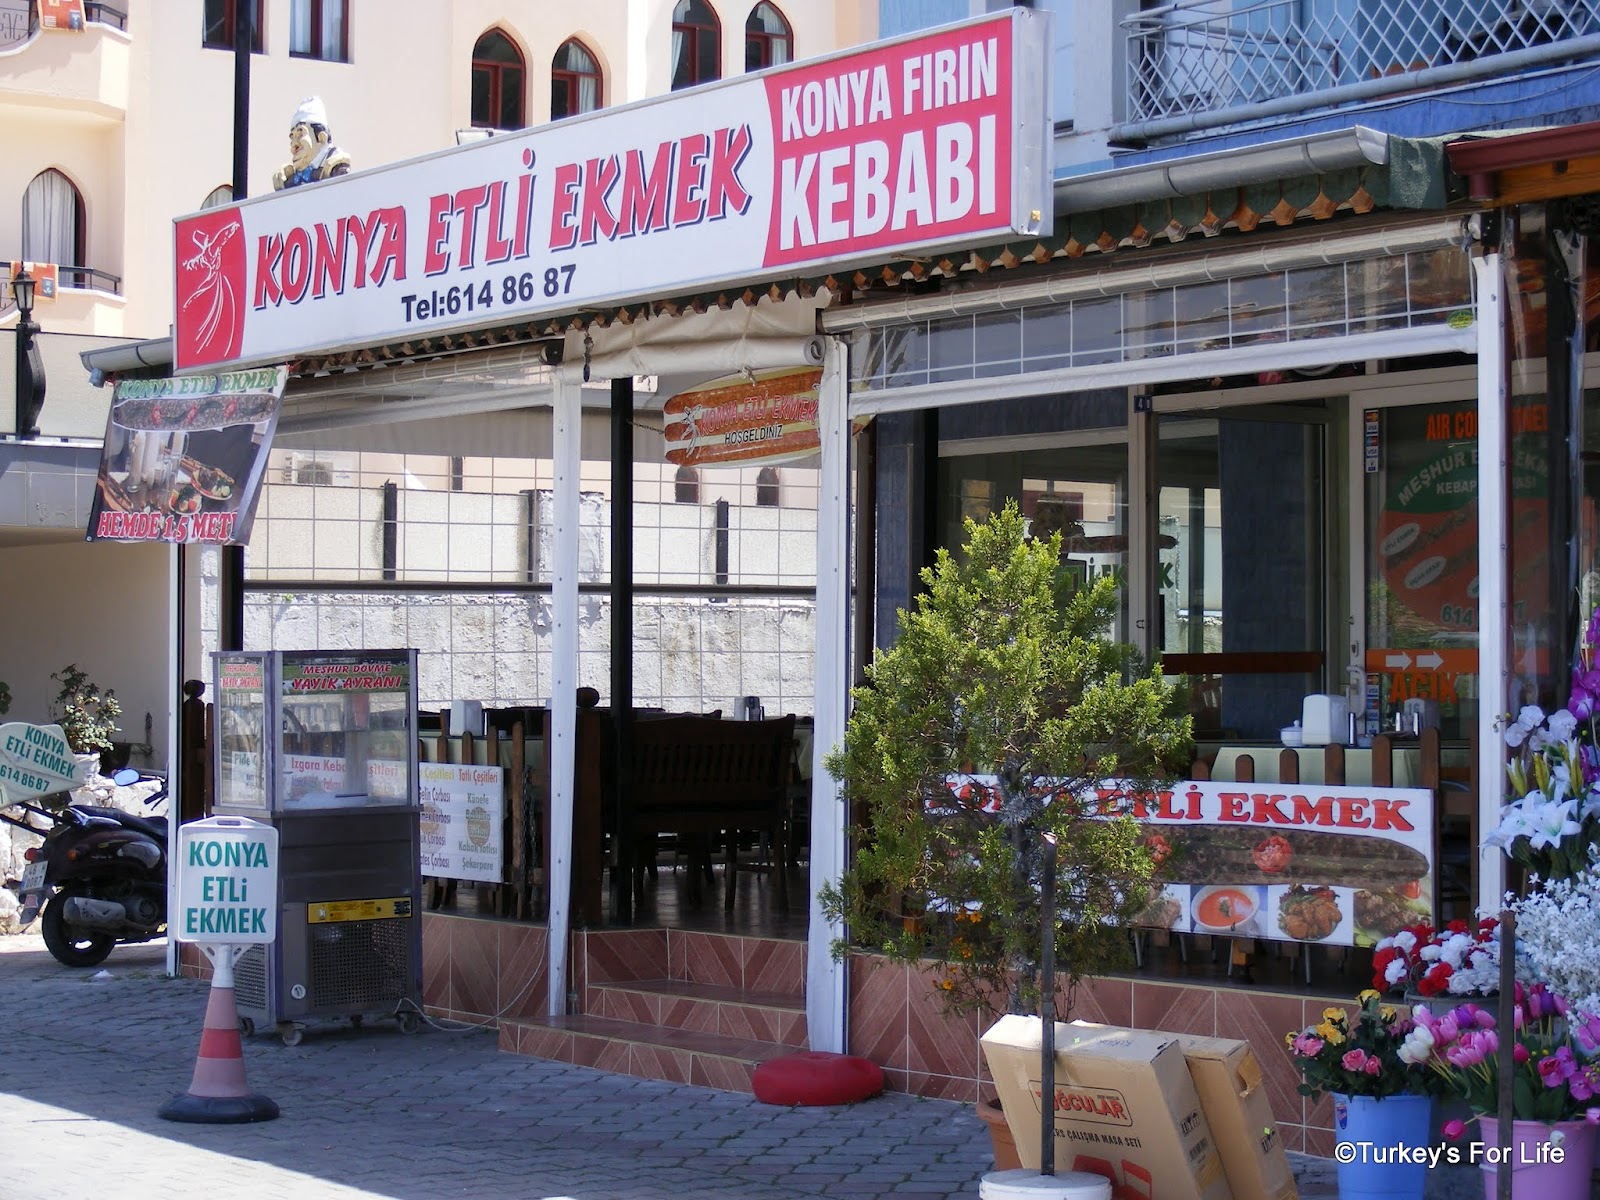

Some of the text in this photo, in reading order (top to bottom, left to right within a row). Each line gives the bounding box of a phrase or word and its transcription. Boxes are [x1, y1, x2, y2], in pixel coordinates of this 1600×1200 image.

[782, 38, 997, 143] KONYA FIRIN
[780, 114, 996, 251] KEBABI
[253, 123, 753, 311] KONYA ETLİ EKMEK
[402, 264, 577, 322] Tel:614 86 87
[118, 379, 174, 400] KONYA
[221, 369, 280, 392] EKMEK
[724, 422, 783, 447] HOŞGELDİNİZ
[1427, 413, 1449, 441] AIR
[1398, 452, 1465, 507] MEŞHUR
[97, 511, 161, 538] HEMDE
[164, 514, 188, 541] 1.5
[1440, 604, 1473, 627] 614
[293, 676, 401, 690] YAYIK AYRANI
[303, 663, 391, 675] MEŞHUR DÖVME
[25, 726, 65, 756] KONYA
[33, 748, 76, 779] EKMEK
[291, 757, 320, 772] Izgara
[1218, 792, 1414, 832] EKMEK
[189, 841, 268, 868] KONYA
[186, 908, 266, 933] EKMEK
[1066, 1130, 1100, 1144] ÇALIŞMA
[1101, 1135, 1123, 1146] MASA
